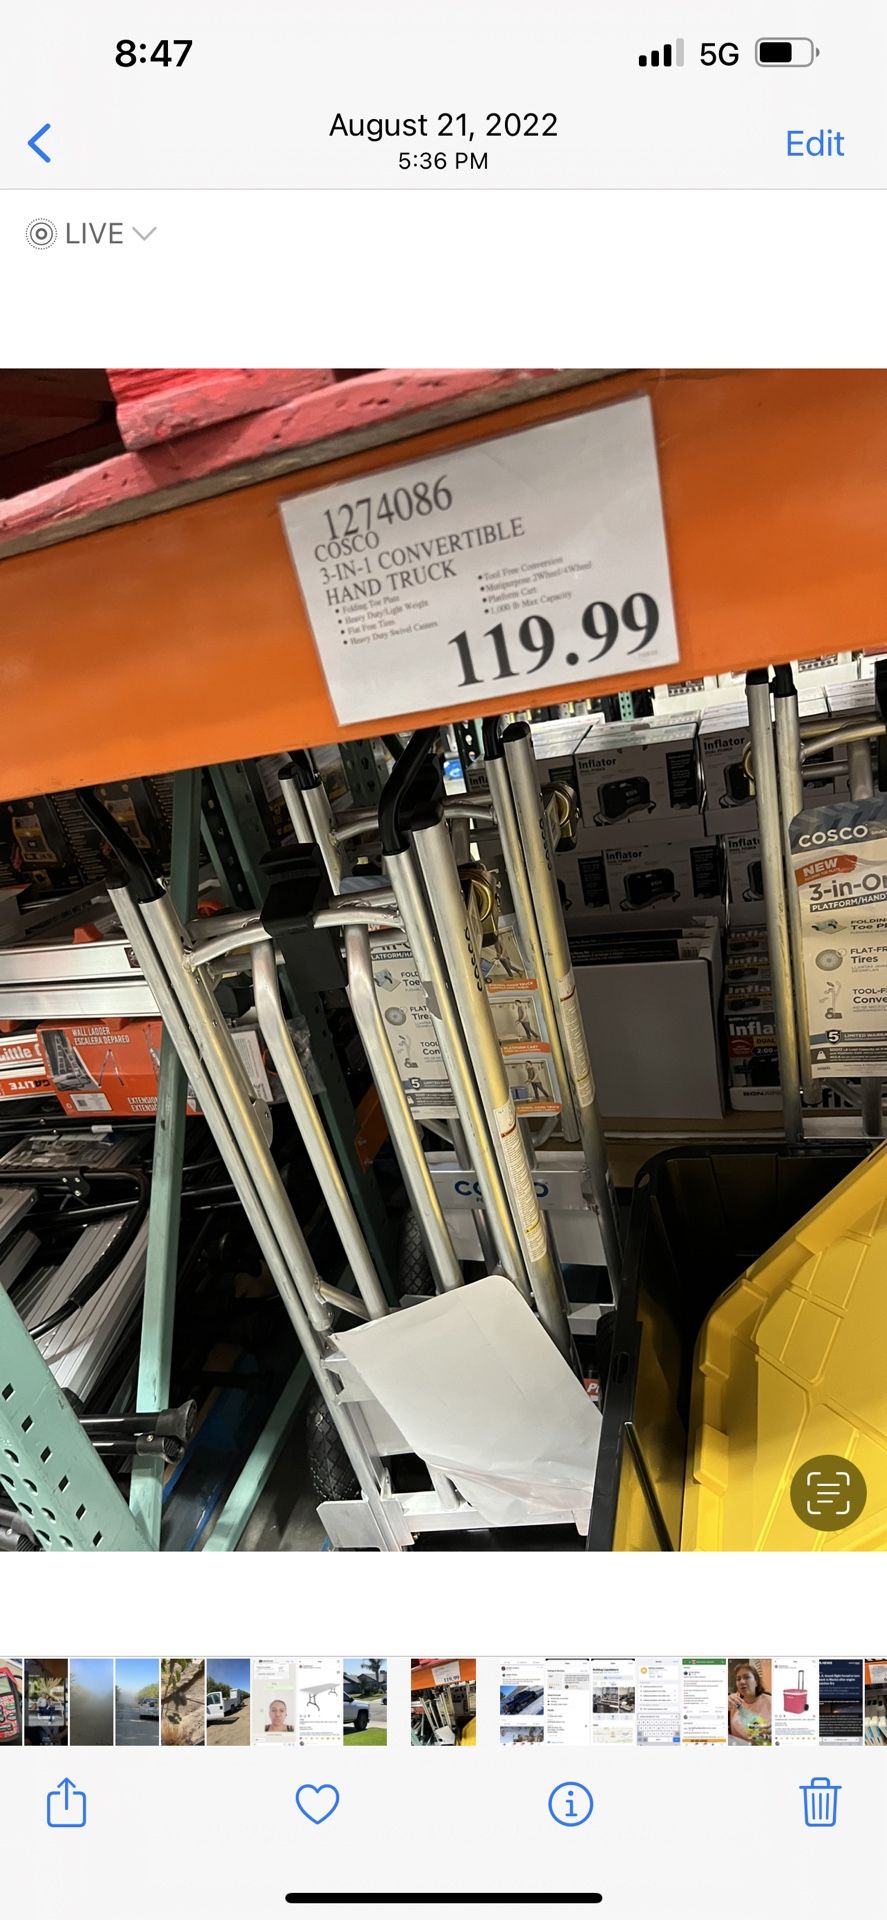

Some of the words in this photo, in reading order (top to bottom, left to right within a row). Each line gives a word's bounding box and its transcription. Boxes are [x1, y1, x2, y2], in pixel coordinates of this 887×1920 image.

[115, 39, 193, 68] 8:47
[699, 42, 740, 68] 5G
[329, 112, 428, 142] August
[436, 113, 475, 141] 21,
[485, 112, 558, 138] 2022
[786, 129, 845, 158] Edit
[398, 152, 447, 170] 5:36
[455, 152, 489, 170] PM
[66, 222, 124, 245] LIVE
[324, 475, 453, 541] 1274086
[314, 531, 380, 563] COSCO
[320, 556, 372, 585] 3-IN-1
[378, 516, 525, 570] CONVERTIBLE
[484, 570, 501, 581] Tool
[502, 565, 519, 577] Free
[521, 556, 564, 573] Conversion
[326, 578, 382, 606] HAND
[387, 559, 457, 592] TRUCK
[488, 591, 519, 603] Platform
[521, 586, 537, 596] Cart
[490, 602, 511, 614] 1,000
[522, 596, 539, 608] Max
[540, 590, 573, 606] Capacity
[345, 614, 366, 625] Heavy
[405, 600, 429, 610] Weight
[350, 636, 371, 646] Heavy
[372, 632, 388, 642] Duty
[448, 592, 660, 687] 119.99
[704, 736, 745, 750] Inflator
[578, 758, 617, 769] Inflator
[799, 825, 868, 848] COSCO
[606, 851, 642, 860] Inflator
[803, 858, 838, 877] NEW
[72, 1027, 87, 1037] WALL
[88, 1026, 110, 1036] LADDER
[729, 1022, 775, 1036] Infla
[829, 1031, 839, 1042] 5
[74, 1037, 103, 1046] ESCALERA
[411, 1079, 420, 1088] 5
